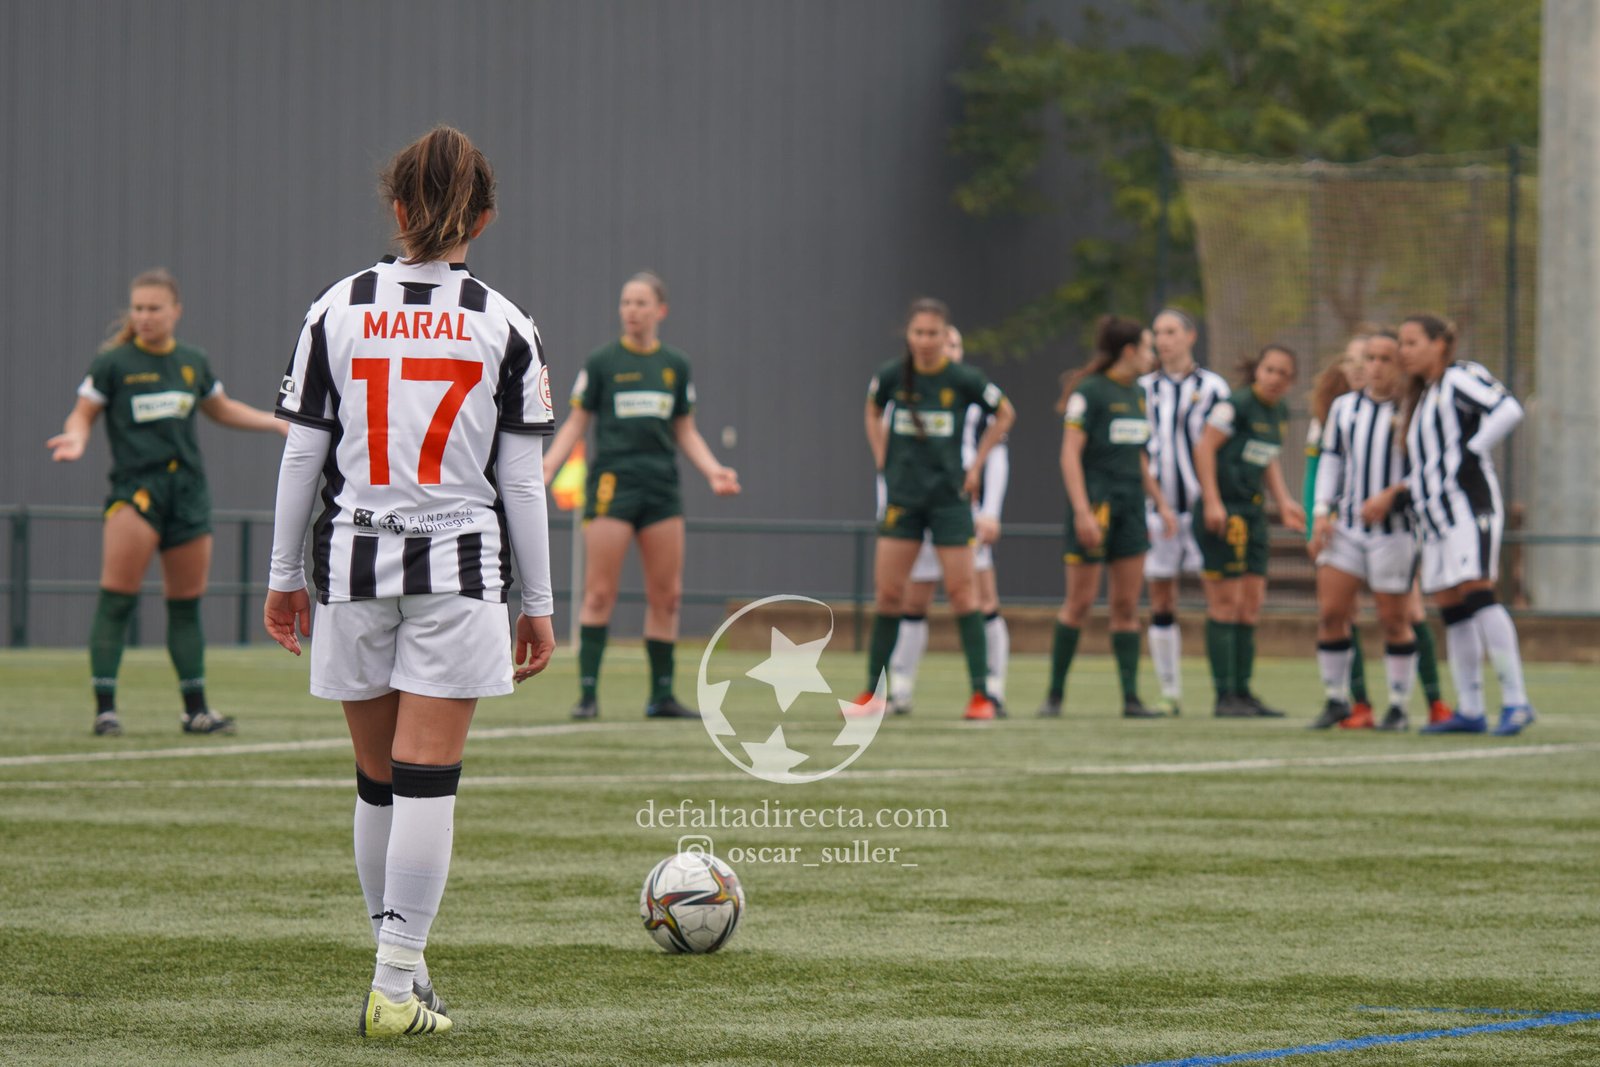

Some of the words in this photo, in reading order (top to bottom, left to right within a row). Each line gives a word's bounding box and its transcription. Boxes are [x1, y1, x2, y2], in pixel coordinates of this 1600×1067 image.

[363, 311, 472, 341] MARAL
[352, 357, 483, 485] 17
[412, 516, 475, 535] albinegra
